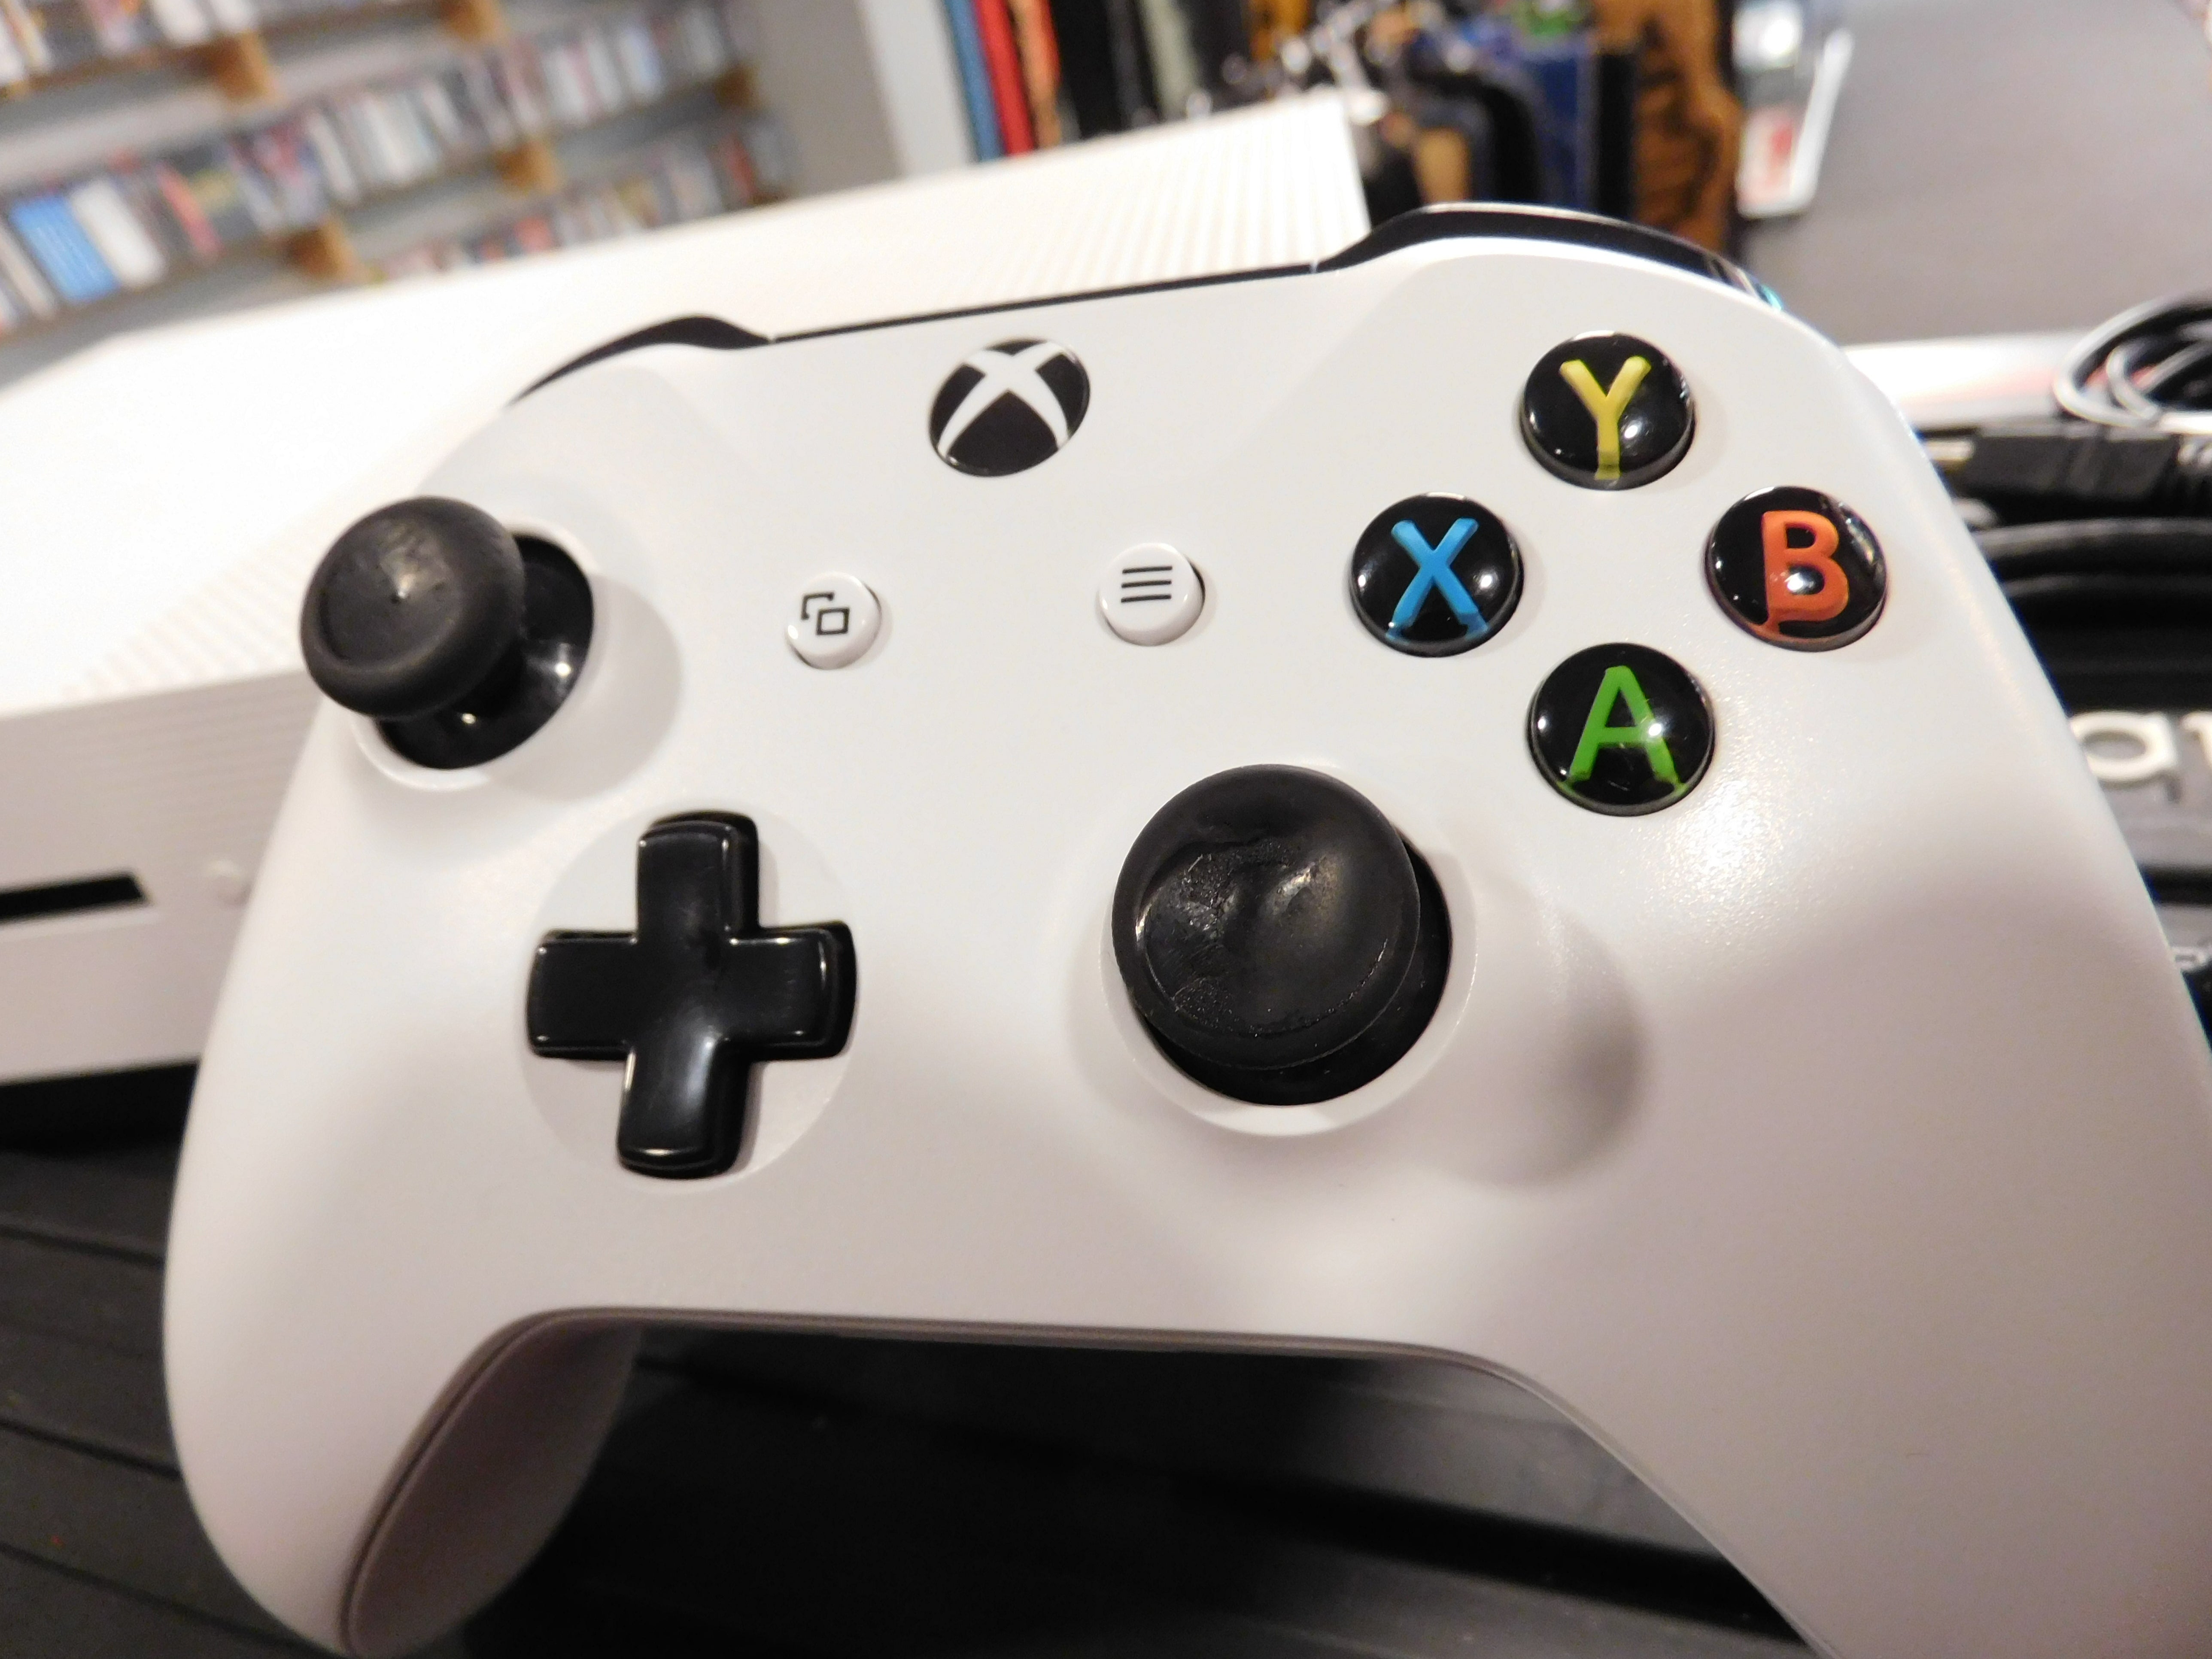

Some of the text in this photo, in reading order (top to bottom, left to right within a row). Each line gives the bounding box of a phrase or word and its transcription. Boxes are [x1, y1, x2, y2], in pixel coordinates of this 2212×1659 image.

[1559, 356, 1651, 480] Y
[1386, 518, 1487, 637] X
[1759, 510, 1849, 627] B
[1565, 665, 1684, 789] A
